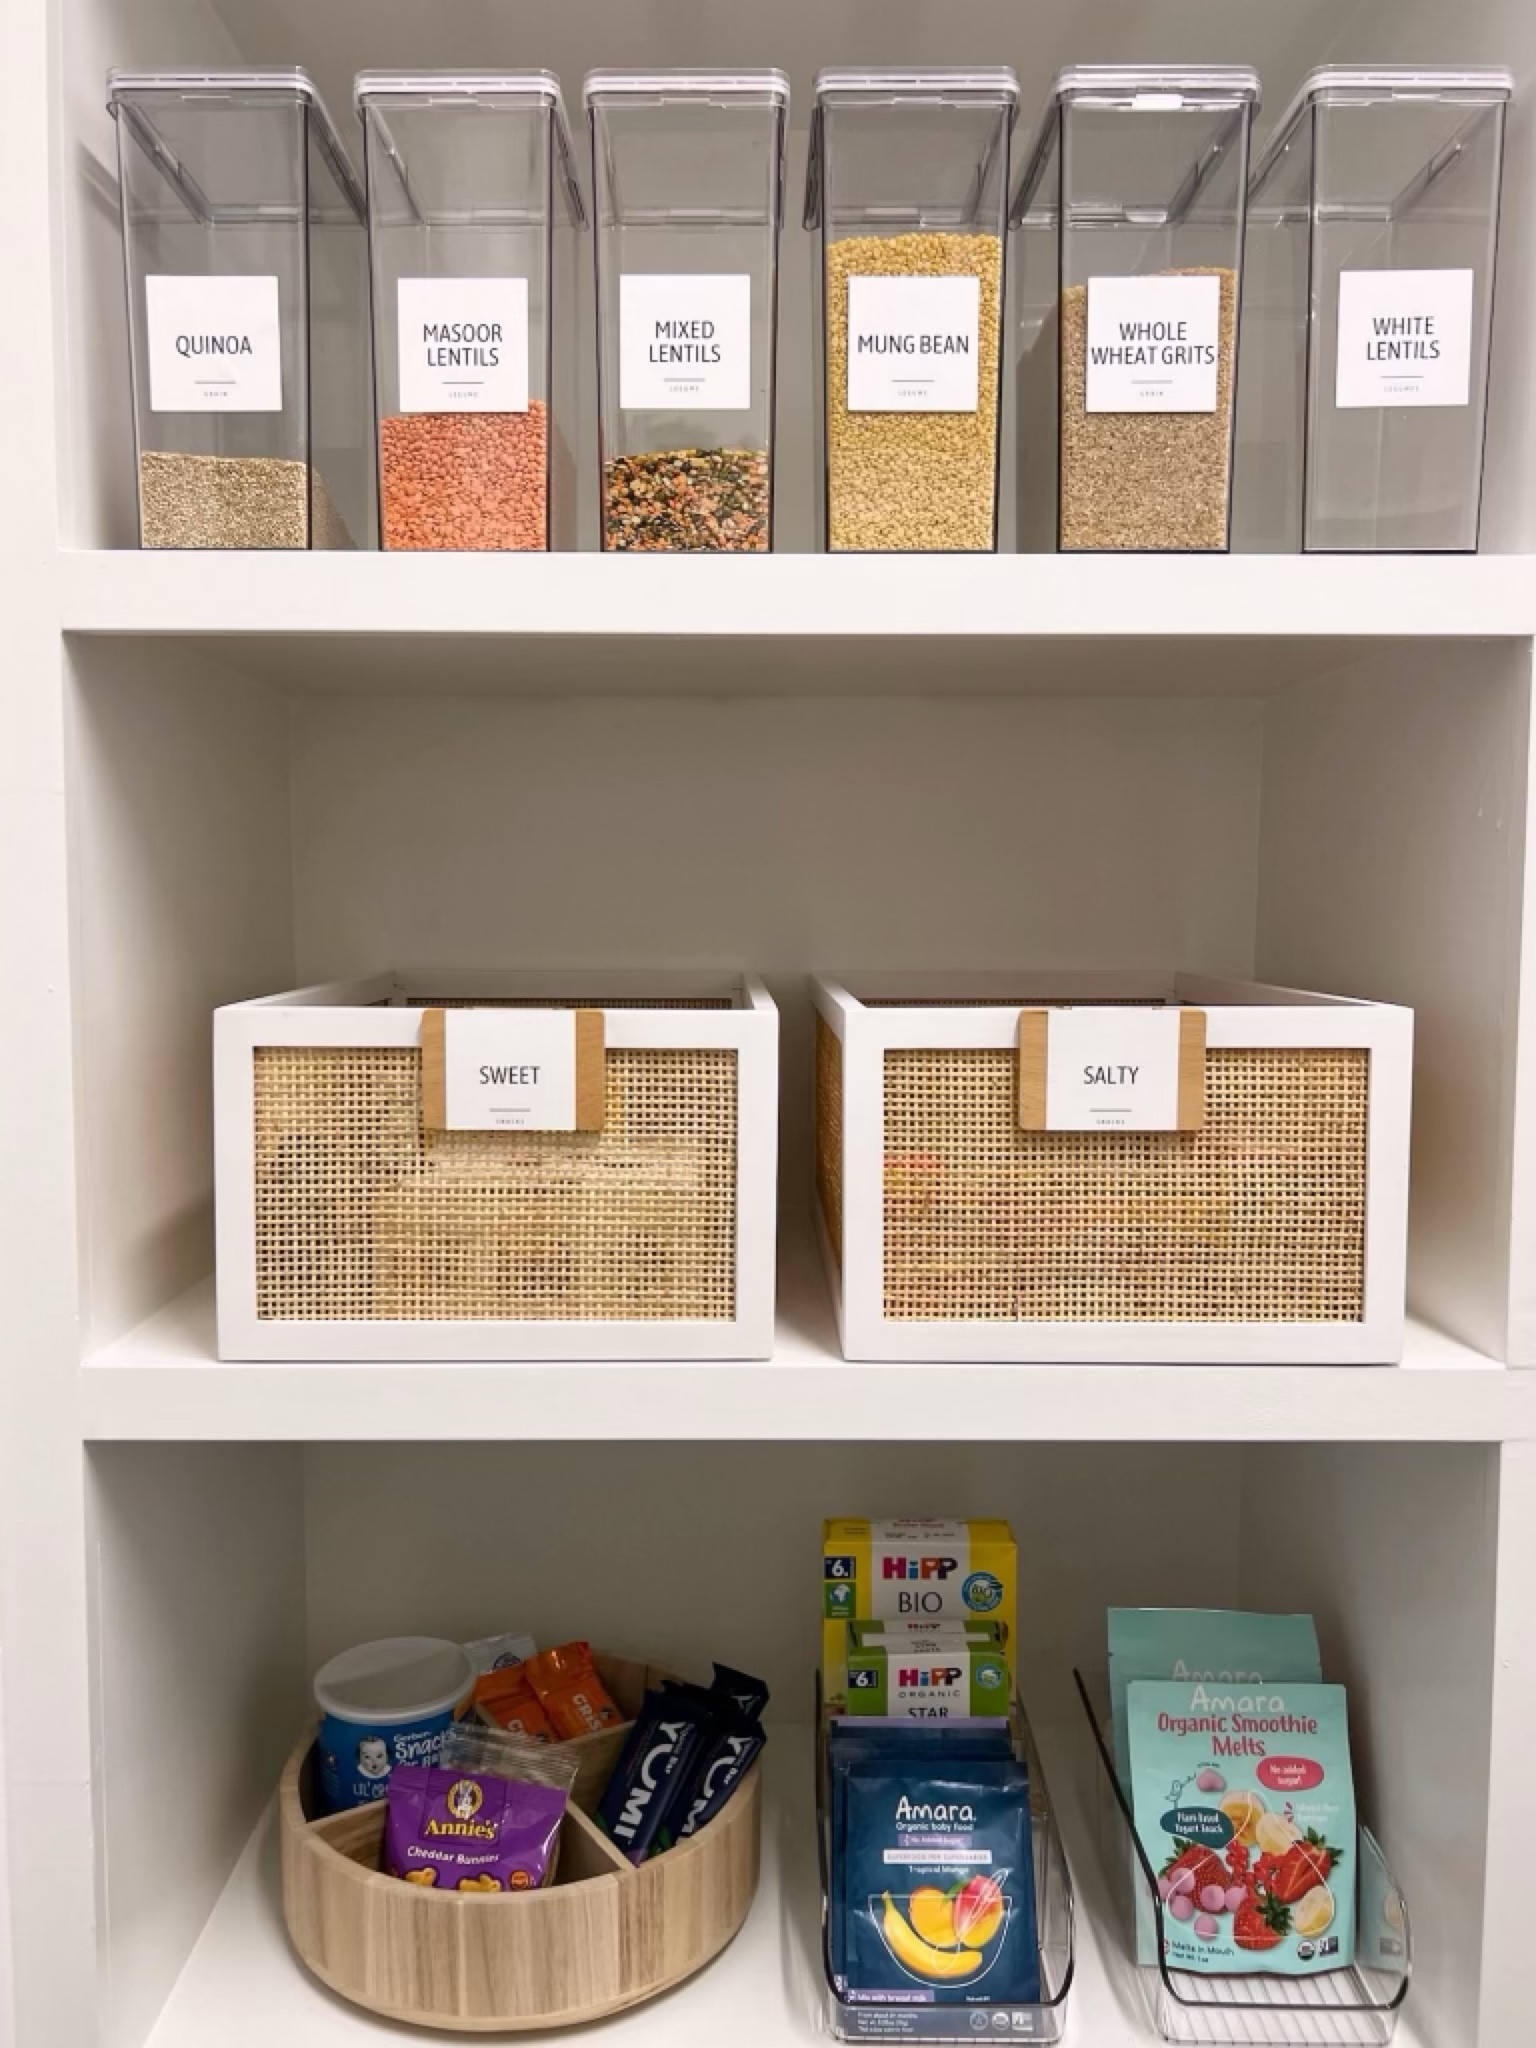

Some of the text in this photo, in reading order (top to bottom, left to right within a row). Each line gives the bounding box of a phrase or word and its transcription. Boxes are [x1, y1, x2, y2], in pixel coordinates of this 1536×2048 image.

[423, 323, 503, 342] MASOOR
[655, 320, 715, 339] MIXED
[1119, 321, 1187, 341] WHOLE
[1373, 316, 1435, 336] WHITE
[175, 334, 253, 358] QUINOA
[649, 344, 721, 363] LENTILS
[857, 335, 969, 354] MUNG BEAN
[1366, 340, 1440, 361] LENTILS
[427, 347, 499, 366] LENTILS
[1091, 345, 1215, 365] WHEAT GRITS
[479, 1065, 541, 1085] SWEET
[1083, 1065, 1139, 1085] SALTY
[898, 1591, 943, 1613] BIO
[898, 1689, 961, 1699] ORGANIC
[1189, 1685, 1286, 1713] Amara
[1157, 1711, 1318, 1736] Organic Smoothie
[1211, 1735, 1266, 1757] Melts
[613, 1721, 688, 1840] YUMI
[681, 1736, 753, 1834] YUM
[423, 1818, 500, 1839] Annie's
[895, 1820, 974, 1833] Organic baby food
[406, 1845, 455, 1862] Cheddar
